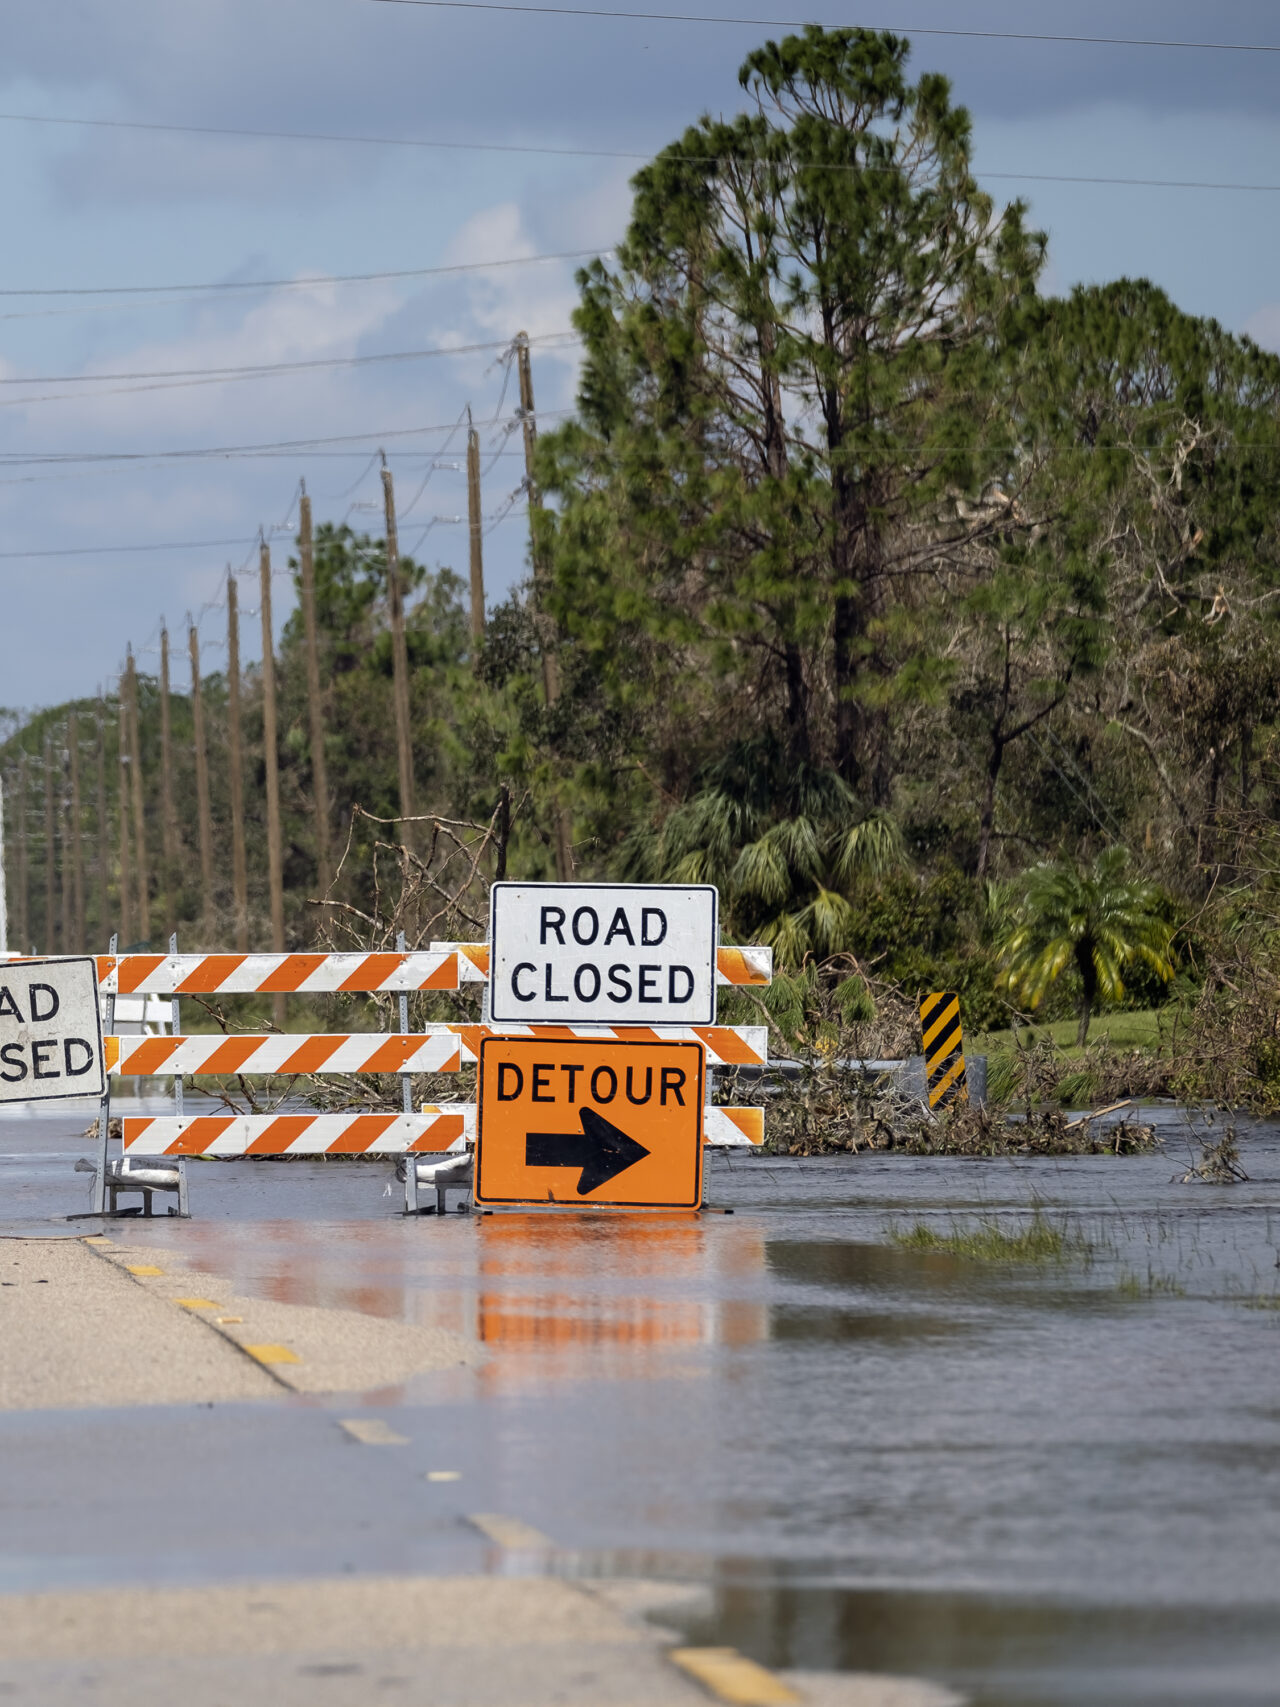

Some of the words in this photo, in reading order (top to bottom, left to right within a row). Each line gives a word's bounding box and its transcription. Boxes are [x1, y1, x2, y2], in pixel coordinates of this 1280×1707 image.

[539, 905, 668, 947] ROAD
[511, 962, 695, 1004] CLOSED
[497, 1062, 686, 1107] DETOUR
